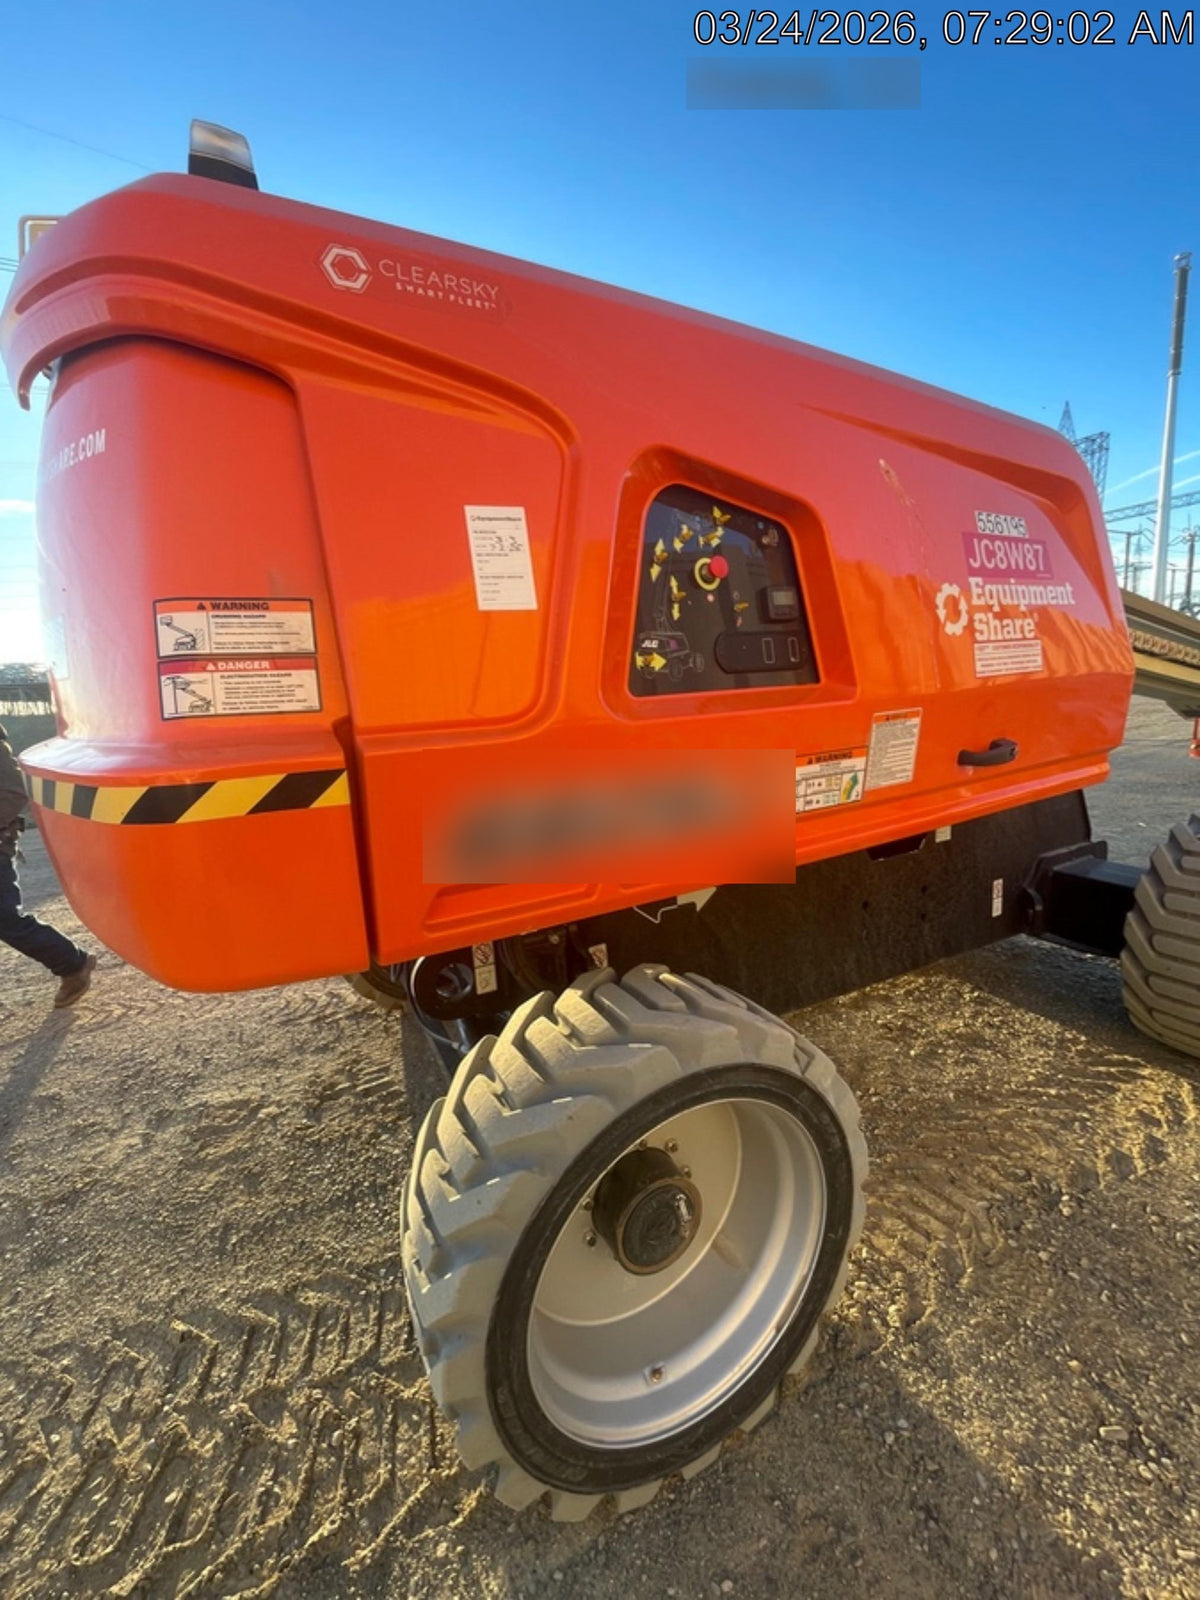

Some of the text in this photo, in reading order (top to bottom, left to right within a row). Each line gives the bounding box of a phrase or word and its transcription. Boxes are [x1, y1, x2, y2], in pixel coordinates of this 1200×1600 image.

[378, 258, 500, 300] CLEARSKY
[396, 282, 443, 300] SMART
[969, 538, 1045, 571] JC8W87
[210, 602, 270, 611] WARNING
[968, 576, 1076, 612] Equipment
[973, 612, 1036, 641] Share
[217, 660, 270, 671] DANGER
